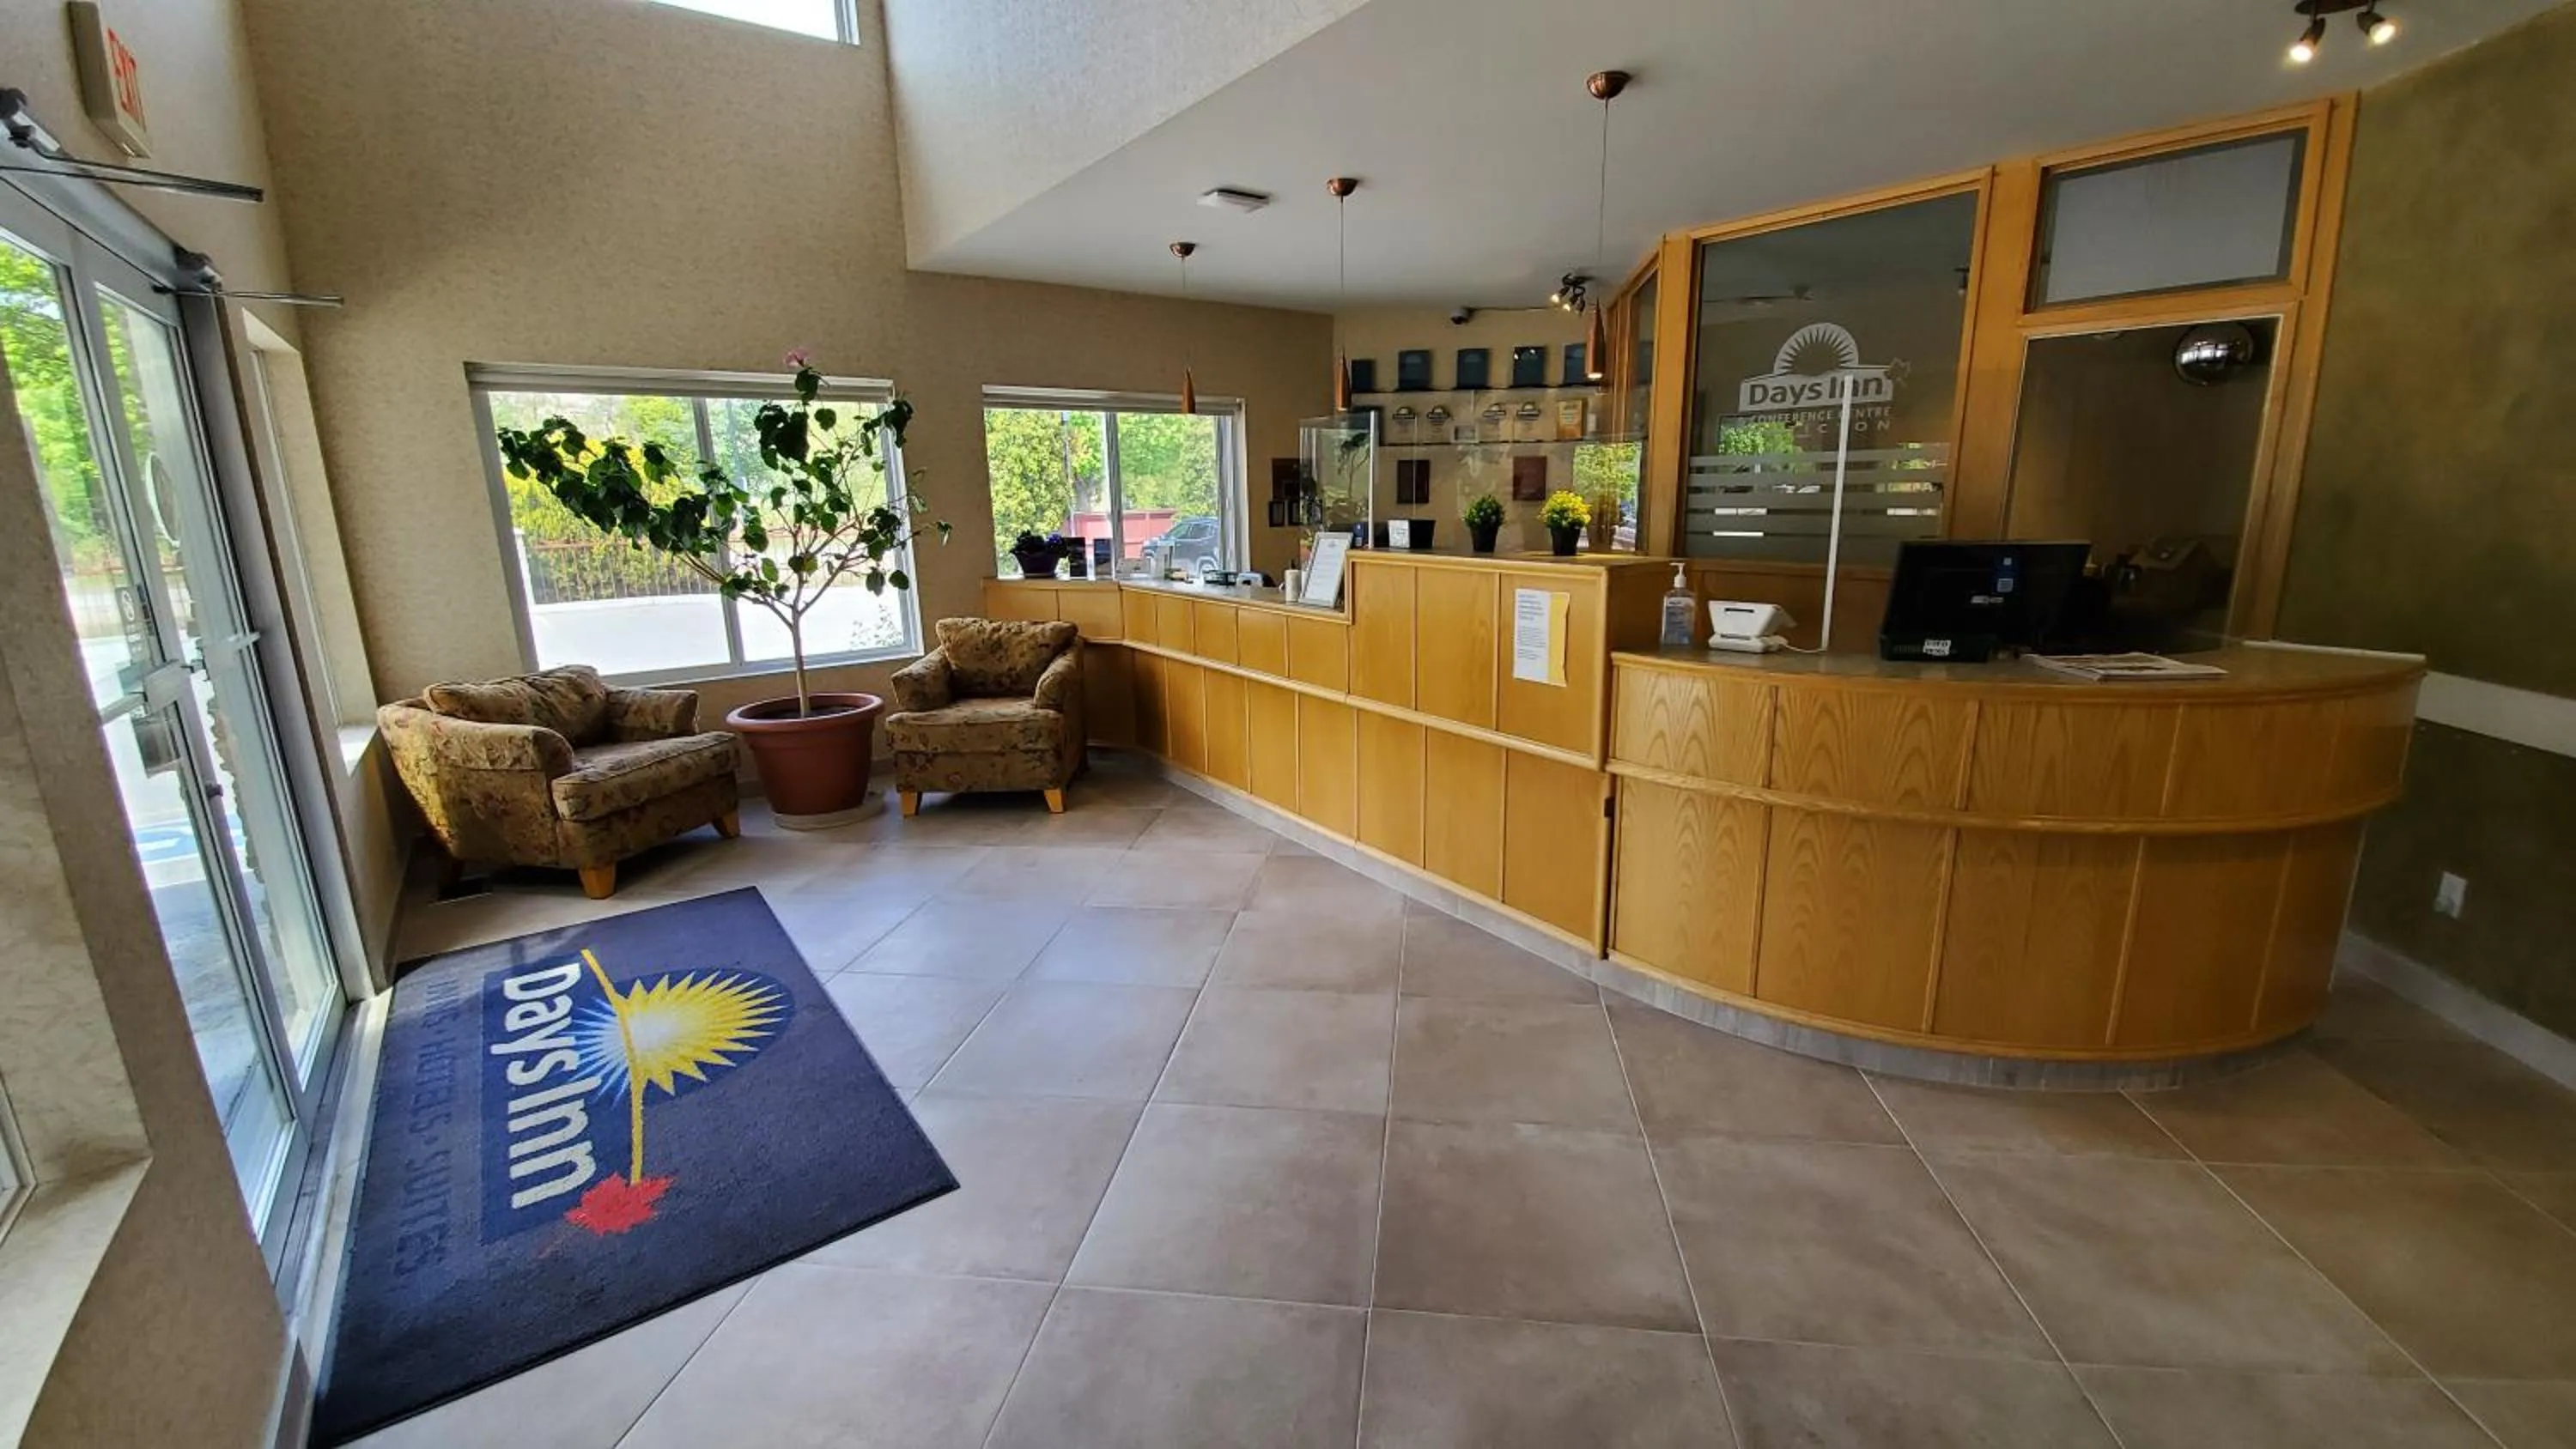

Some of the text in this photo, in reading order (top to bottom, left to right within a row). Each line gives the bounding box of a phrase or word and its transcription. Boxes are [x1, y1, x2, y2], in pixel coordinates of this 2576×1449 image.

[1749, 380, 1822, 405] Days
[409, 1036, 457, 1135] HOTELS
[490, 962, 602, 1210] Days Inn
[393, 1150, 453, 1277] SUITES
